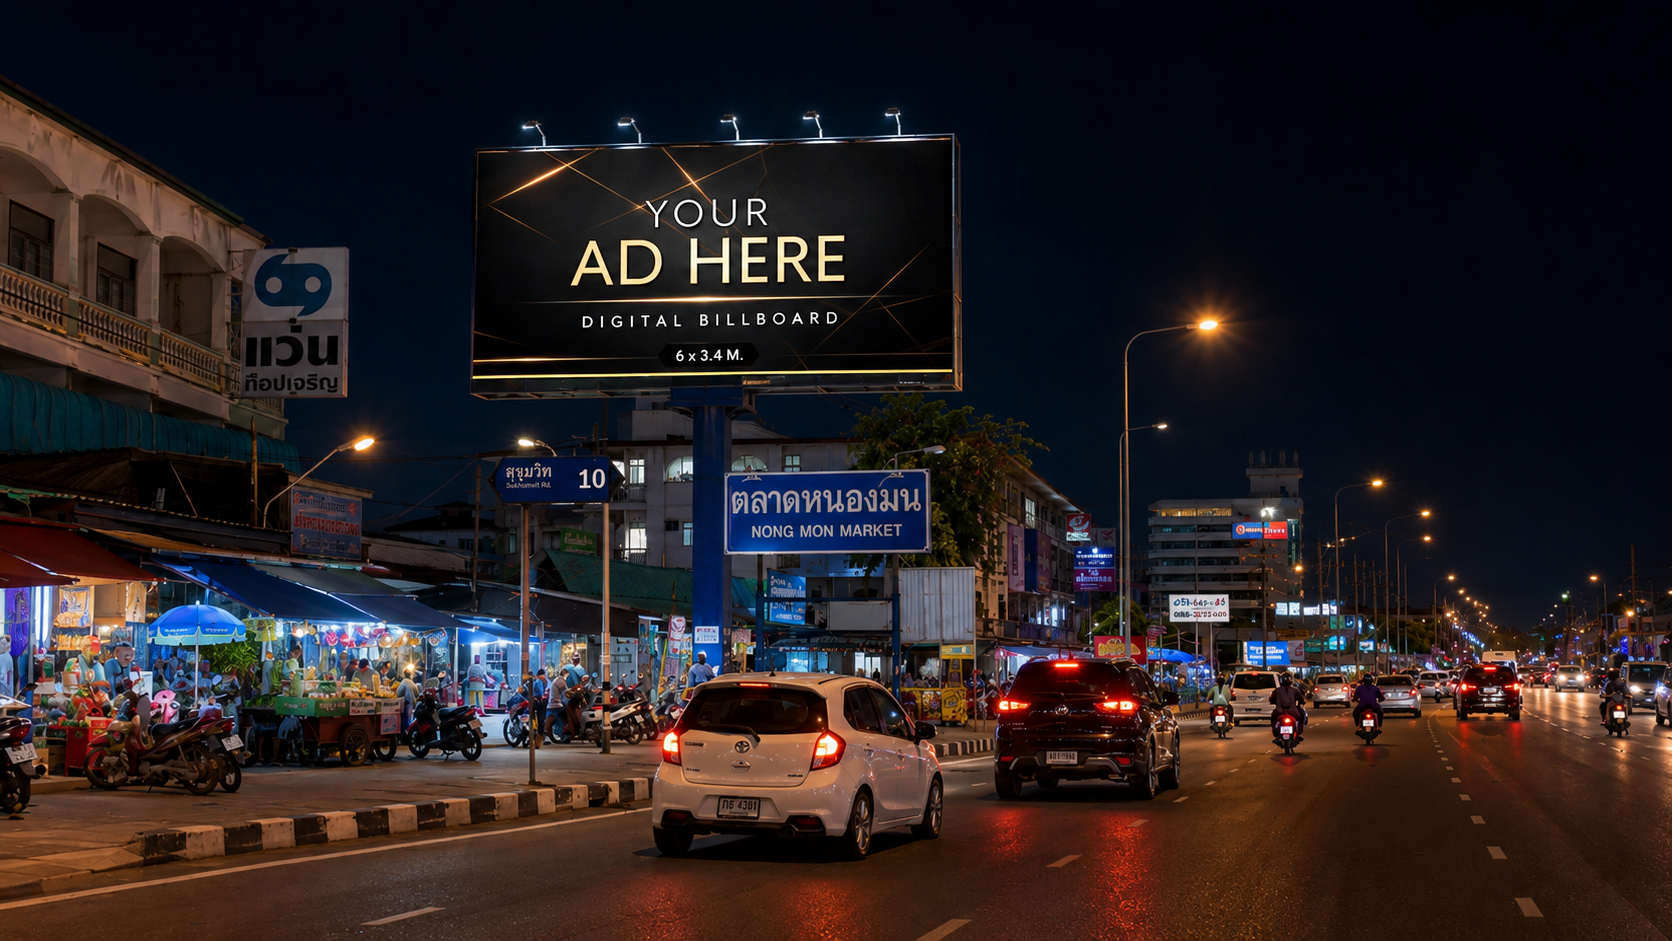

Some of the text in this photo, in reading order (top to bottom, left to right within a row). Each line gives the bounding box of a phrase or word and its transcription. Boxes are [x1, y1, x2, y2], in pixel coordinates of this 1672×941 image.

[645, 198, 768, 228] YOUR
[571, 234, 845, 286] AD HERE
[582, 311, 838, 329] DIGITAL BILLBOARD
[245, 325, 339, 367] แว่น
[675, 348, 744, 362] 6 x 3.4 M.
[245, 373, 338, 393] ท็อปเจริญ
[579, 468, 606, 489] 10
[731, 488, 921, 514] ตลาดหนองมน
[751, 523, 903, 538] NONG MON MARKET
